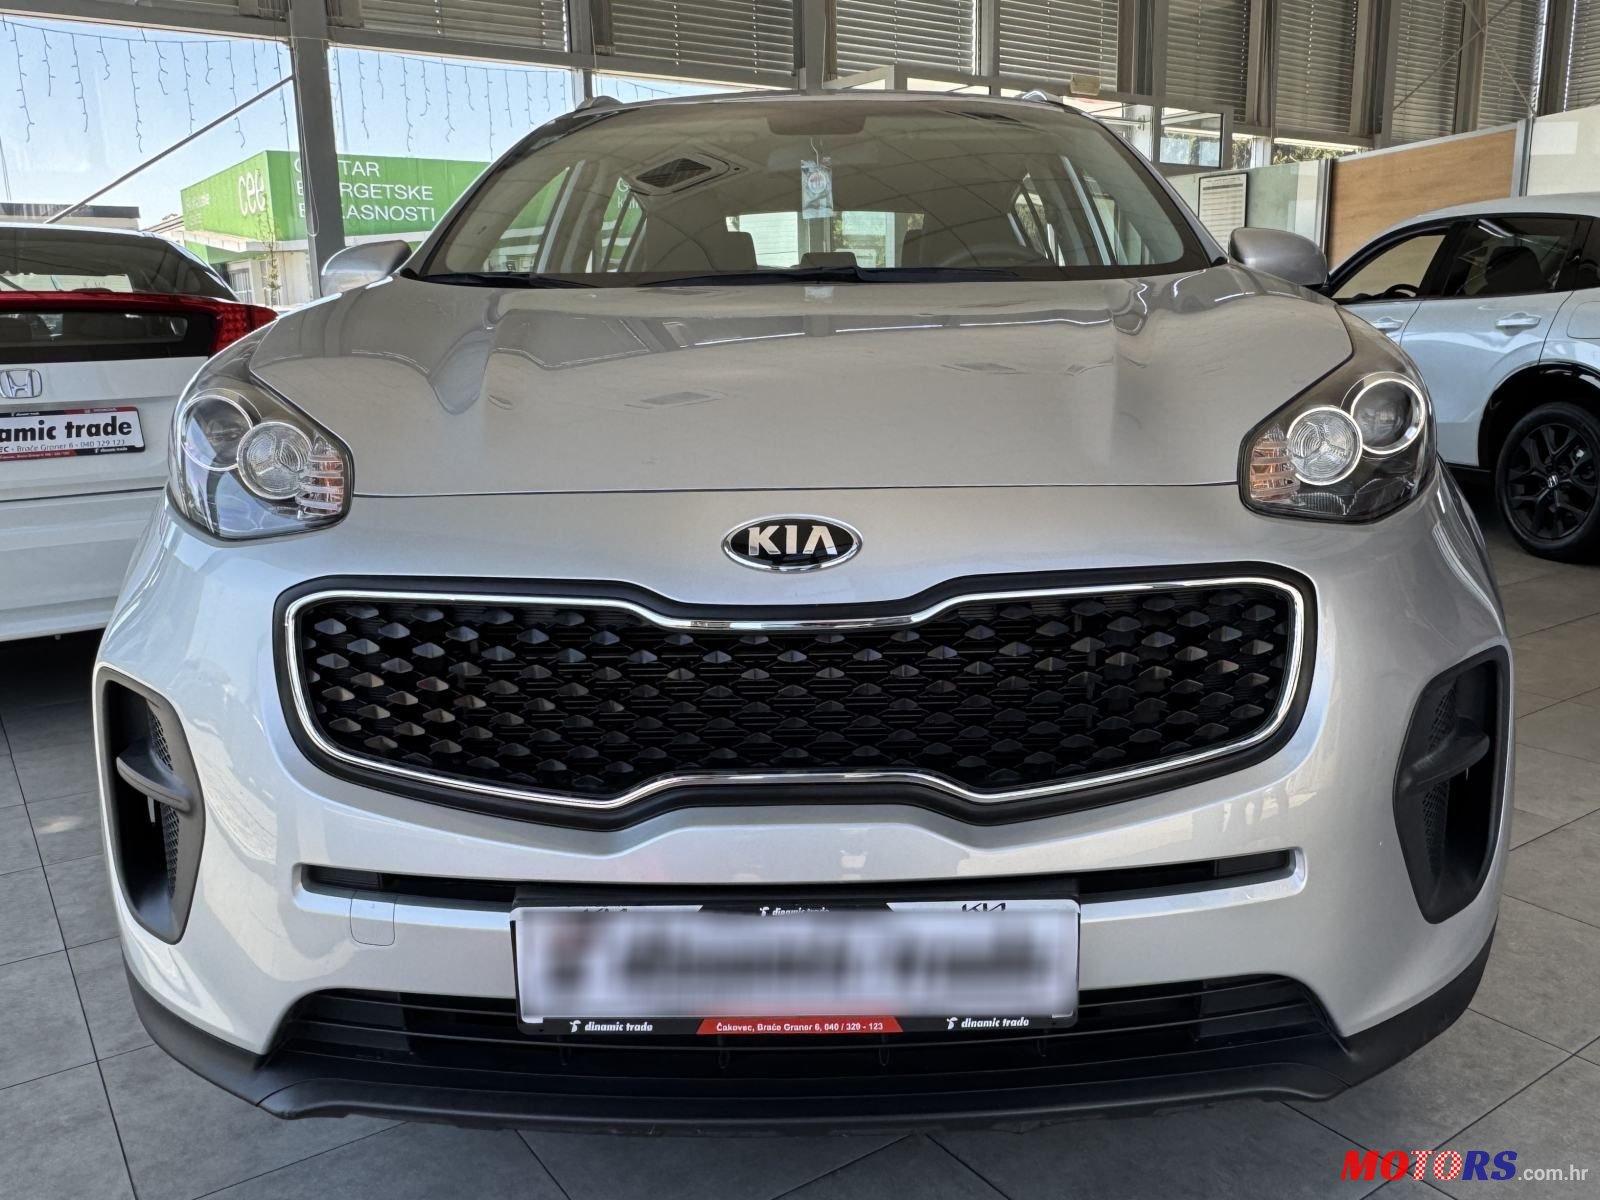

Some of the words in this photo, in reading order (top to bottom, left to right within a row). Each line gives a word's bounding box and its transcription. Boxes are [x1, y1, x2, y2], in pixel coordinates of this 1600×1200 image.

[294, 159, 380, 177] CTAR
[297, 180, 434, 201] ERGETSKE
[299, 203, 436, 222] EASNOSTI
[65, 416, 132, 438] trade
[747, 524, 838, 556] KIA
[584, 1021, 624, 1032] dinamic
[625, 1021, 654, 1032] trade
[824, 1023, 840, 1031] 040
[868, 1022, 884, 1031] 123
[960, 1017, 1001, 1028] dinamic
[1002, 1016, 1030, 1027] trade
